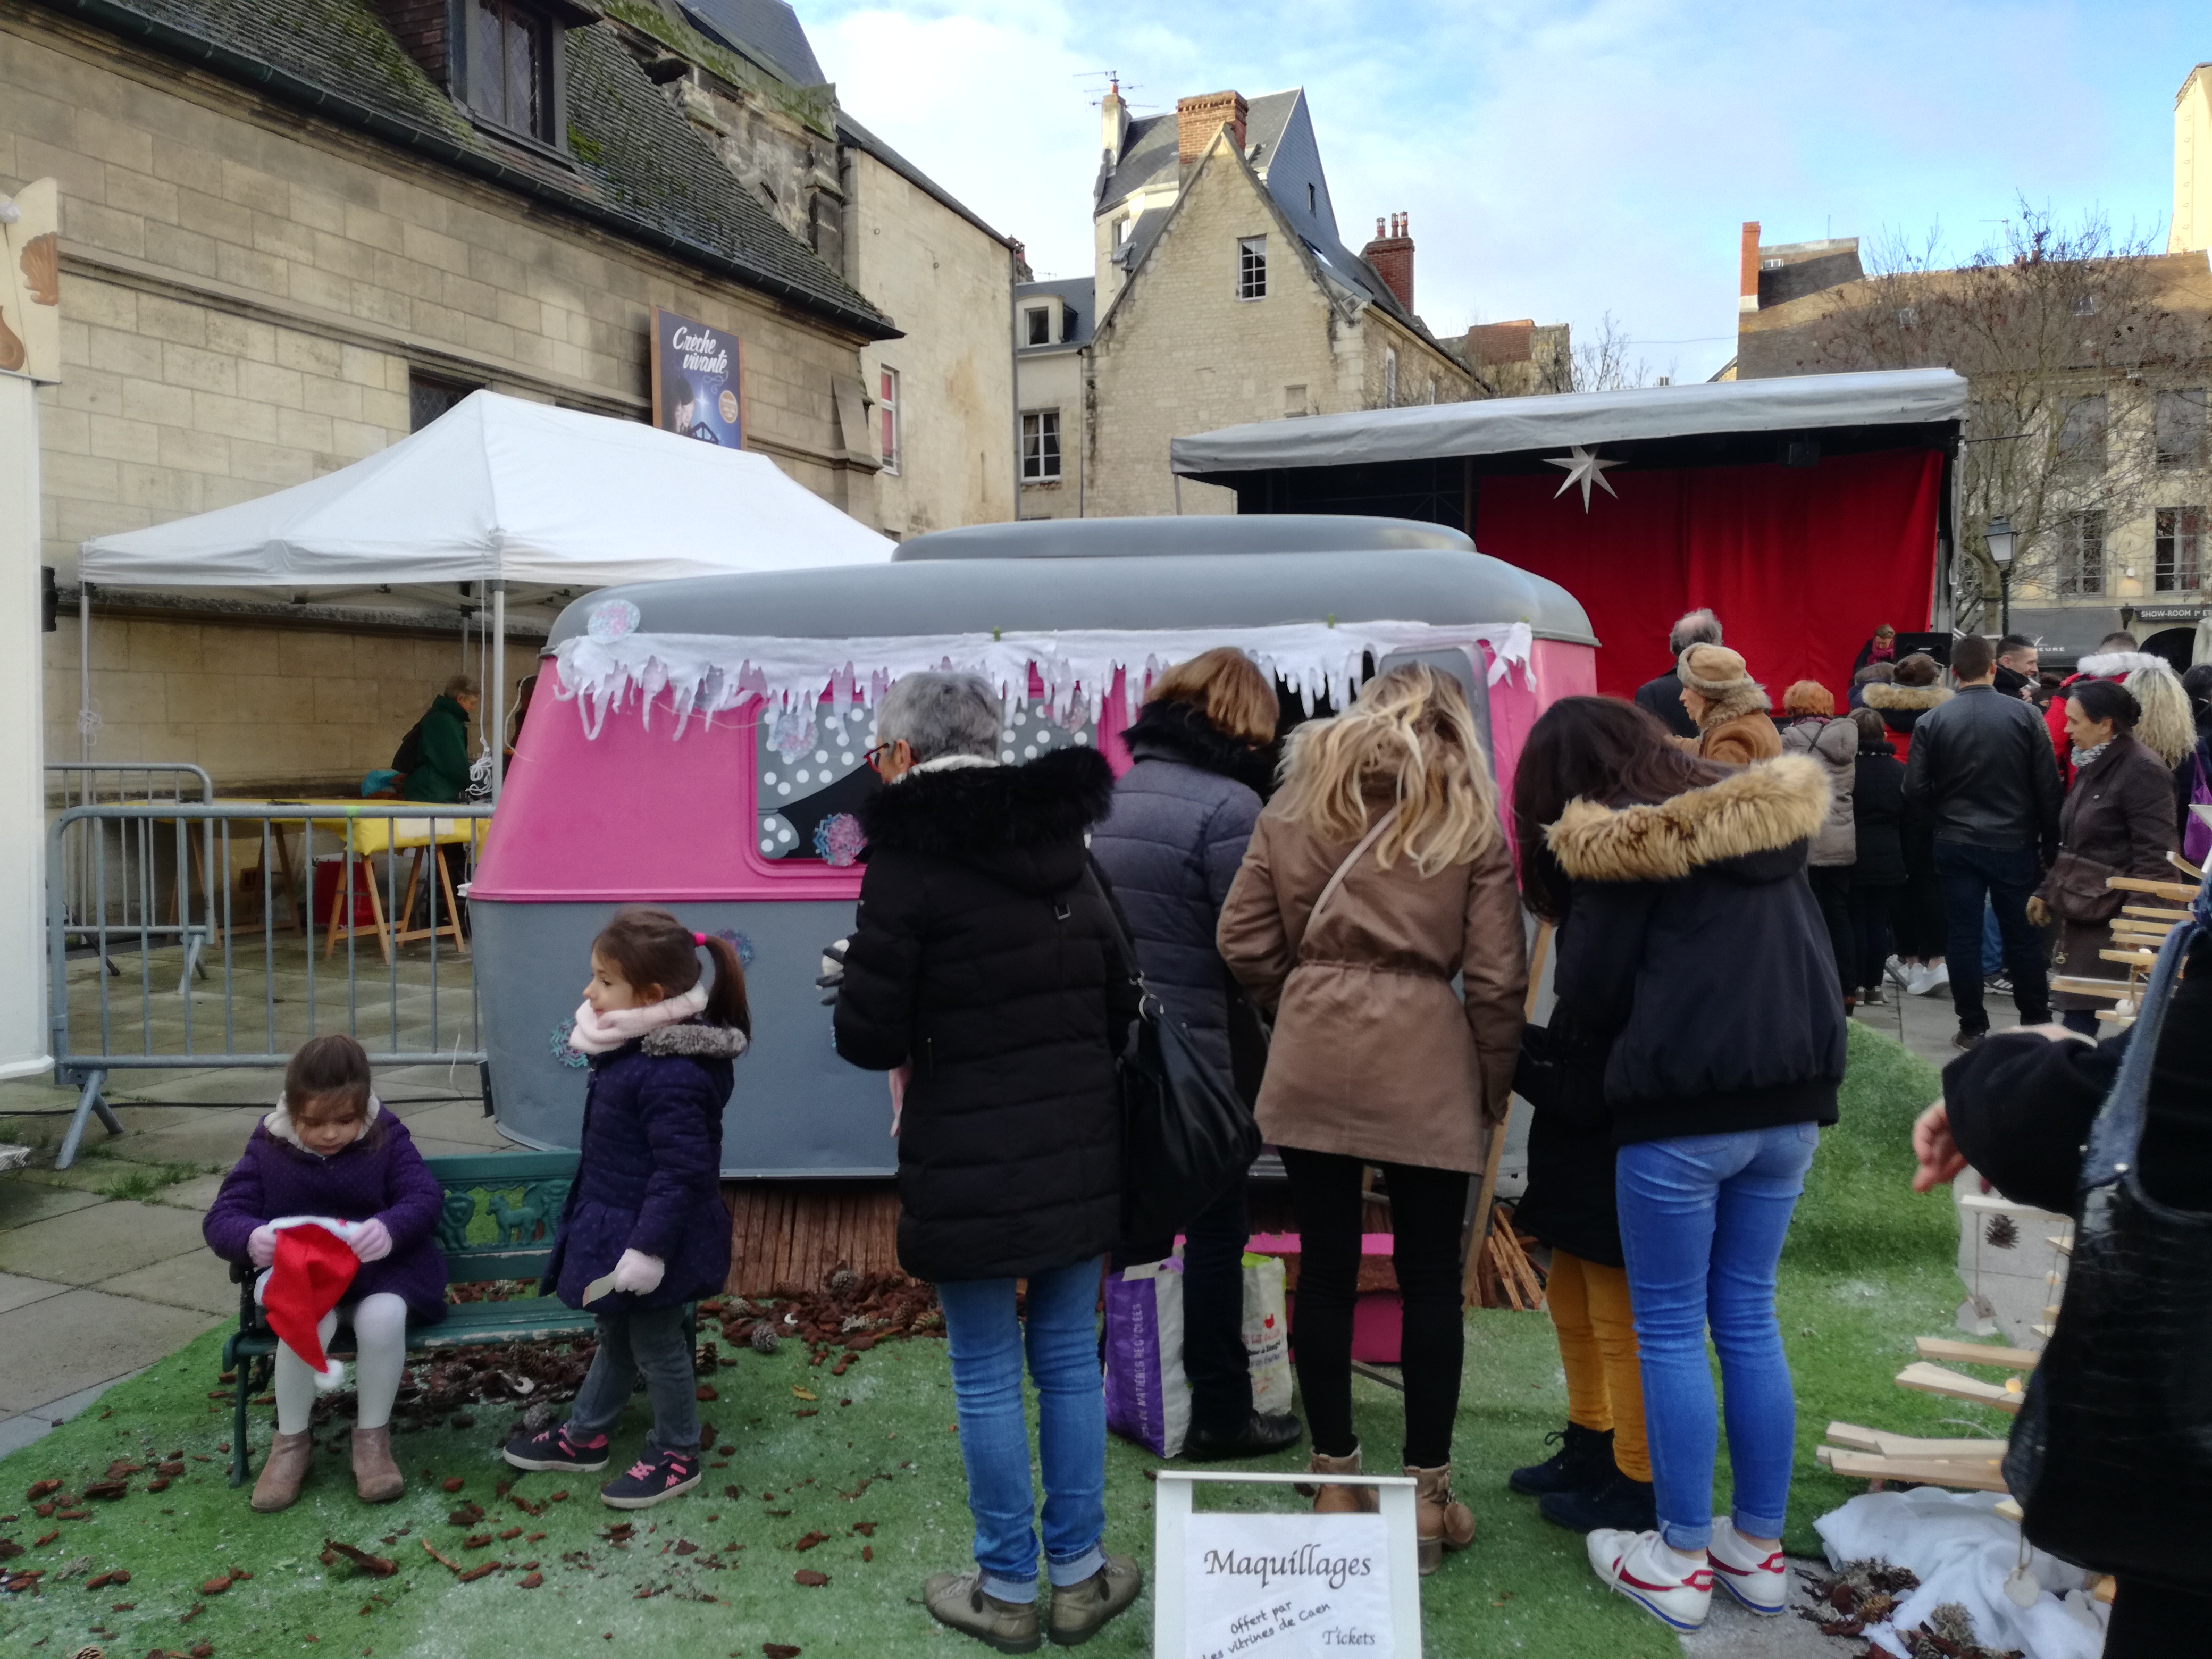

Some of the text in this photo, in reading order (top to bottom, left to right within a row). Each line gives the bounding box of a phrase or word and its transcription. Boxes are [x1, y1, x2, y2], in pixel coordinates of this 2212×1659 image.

[673, 326, 717, 355] Crèche
[683, 349, 727, 374] vivante
[1204, 1543, 1371, 1589] Maquillages
[1272, 1601, 1292, 1622] par
[1228, 1627, 1275, 1653] vitrines
[1279, 1617, 1296, 1631] de
[1298, 1603, 1331, 1622] Caen
[1322, 1626, 1376, 1646] Tickets
